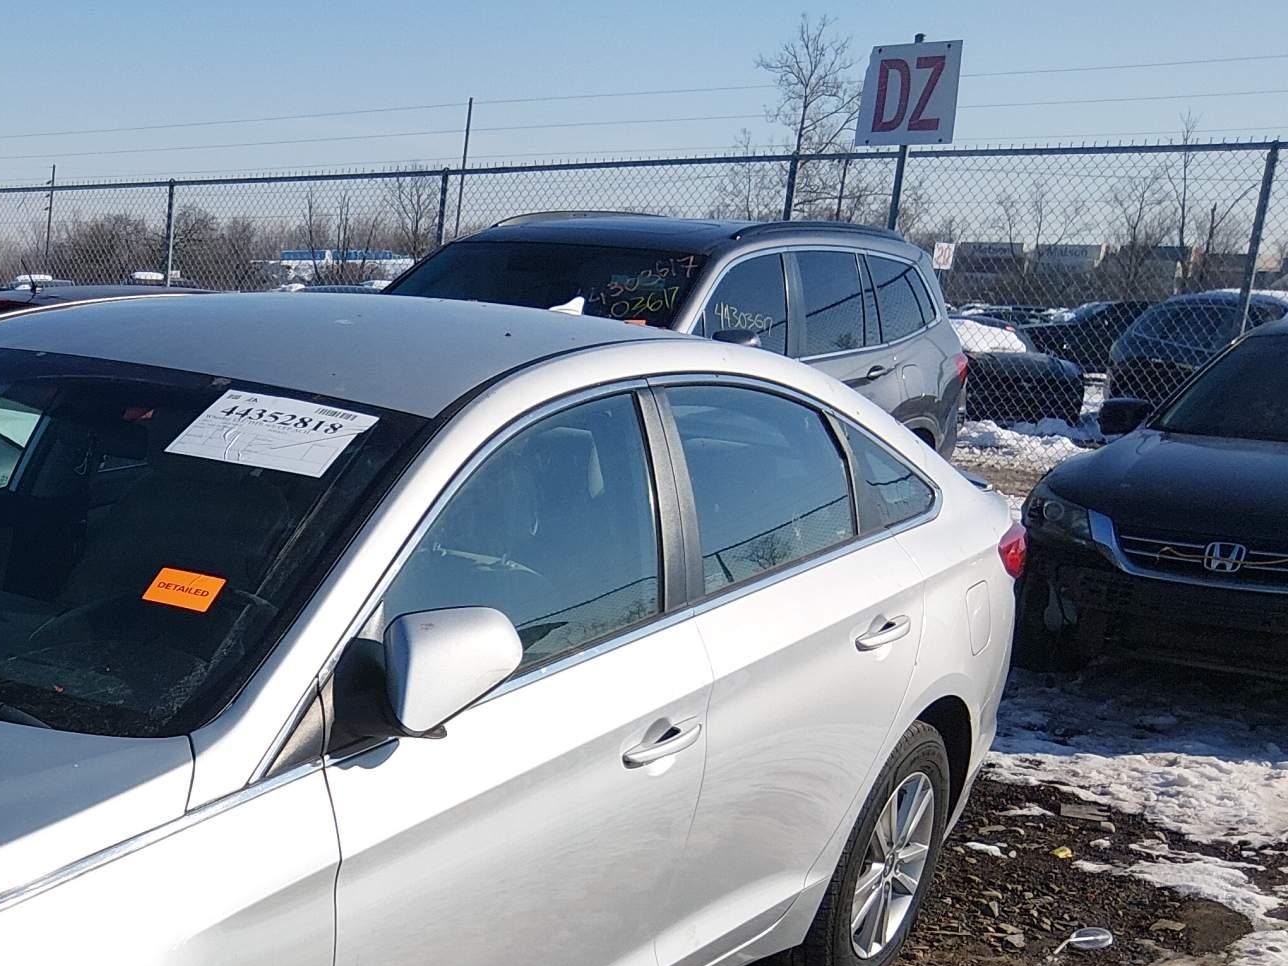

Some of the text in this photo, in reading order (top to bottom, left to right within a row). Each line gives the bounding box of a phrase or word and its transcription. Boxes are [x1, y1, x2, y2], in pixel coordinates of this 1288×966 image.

[871, 55, 946, 132] DZ
[220, 405, 344, 435] 44352818
[157, 581, 210, 598] DETAILED
